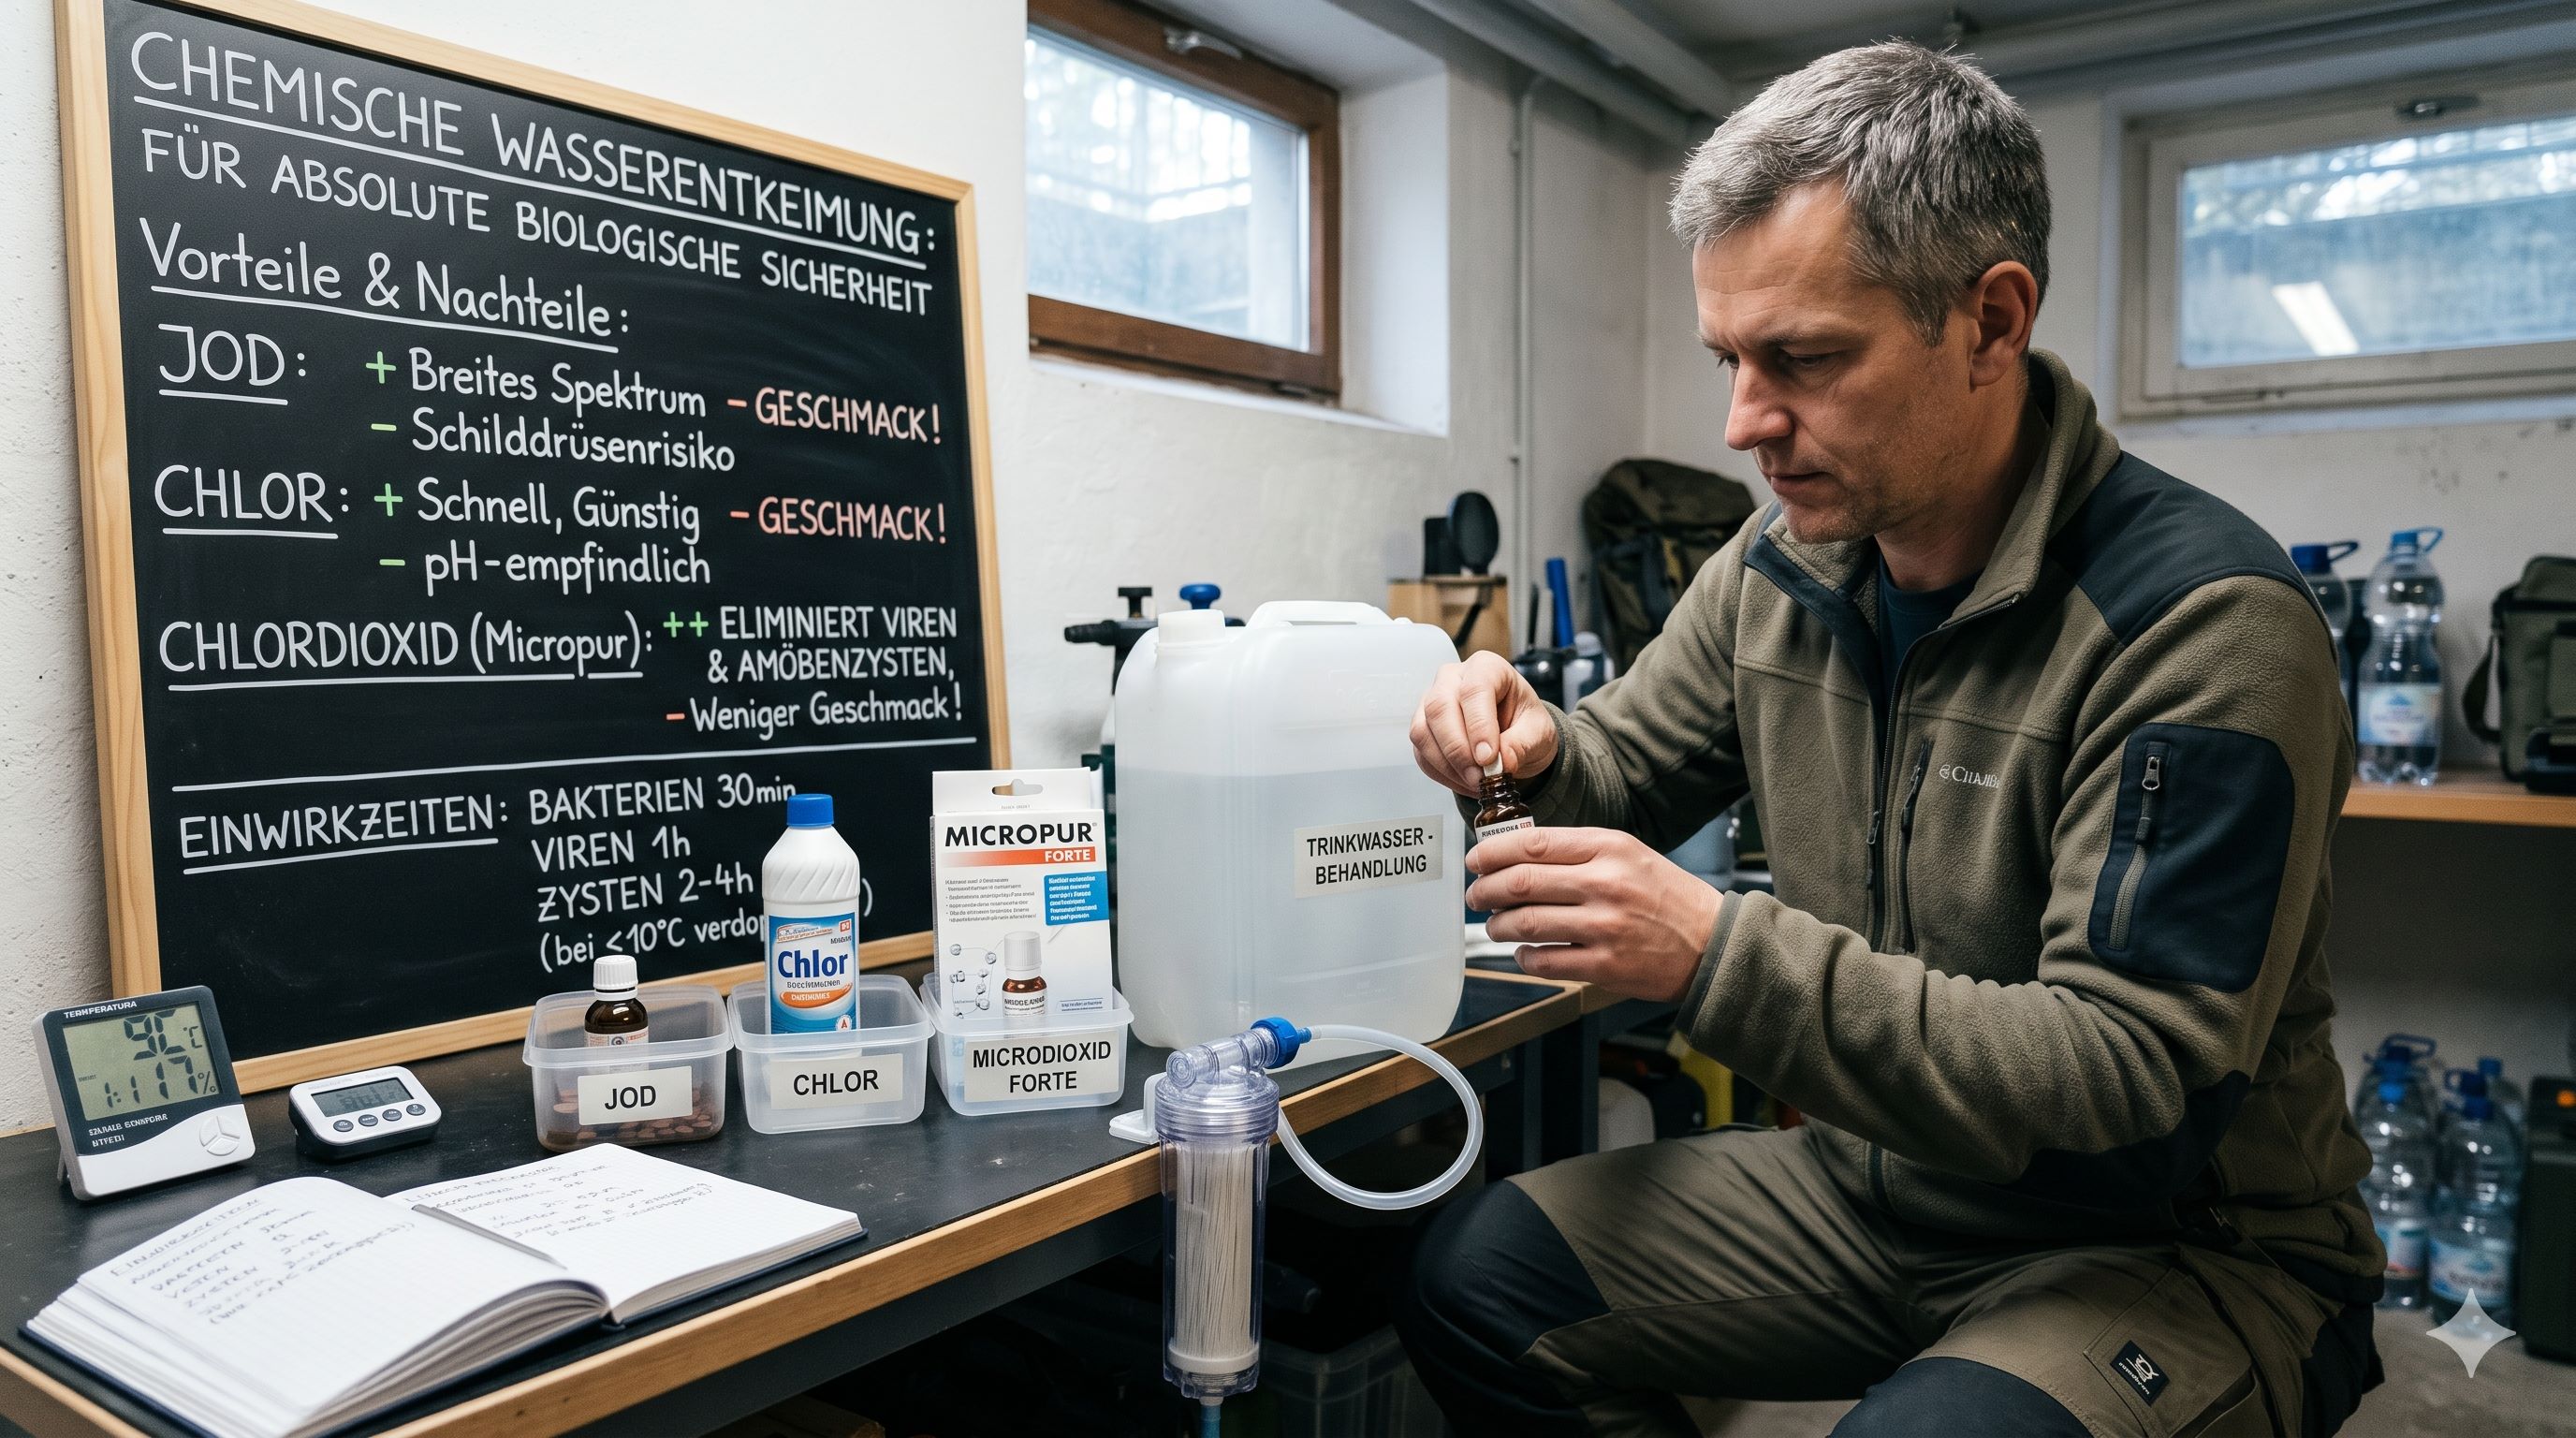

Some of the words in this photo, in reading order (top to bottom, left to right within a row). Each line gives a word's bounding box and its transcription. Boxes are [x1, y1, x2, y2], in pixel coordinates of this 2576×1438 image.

[131, 31, 464, 156] CHEMISCHE
[491, 113, 934, 255] WASSERENTKEIMUNG:
[141, 123, 246, 188] FÜR
[271, 154, 490, 232] ABSOLUTE
[516, 201, 740, 278] BIOLOGISCHE
[762, 251, 932, 315] SICHERHEIT
[139, 217, 342, 299] Vorteile
[365, 252, 400, 309] &
[417, 261, 628, 336] Nachteile:
[158, 324, 306, 386] JOD:
[409, 347, 537, 400] Breites
[551, 362, 706, 418] Spektrum
[755, 388, 940, 444] GESCHMACK!
[413, 407, 735, 471] Schilddrüsenrisiko
[154, 464, 348, 522] CHLOR:
[418, 477, 562, 535] Schnell,
[574, 486, 699, 545] Günstig
[759, 497, 945, 543] GESCHMACK!
[426, 539, 710, 596] pH-empfindlich
[160, 621, 458, 671] CHLORDIOXID
[471, 610, 651, 676] (Micropur):
[721, 606, 873, 639] ELIMINIERT
[882, 607, 956, 638] VIREN
[709, 649, 728, 682] &
[738, 643, 954, 682] AMÖBENZYSTEN,
[690, 697, 799, 741] Weniger
[810, 682, 961, 725] Geschmack!
[181, 794, 507, 858] EINWIRKZEITEN:
[530, 777, 703, 825] BAKTERIEN
[945, 823, 1093, 847] MICROPUR
[532, 829, 634, 872] VIREN
[652, 826, 690, 858] 1h
[1045, 849, 1090, 862] FORTE
[1307, 828, 1424, 857] TRINKWASSER
[538, 873, 664, 922] ZYSTEN
[679, 862, 753, 902] 2-4h
[1316, 854, 1427, 885] BEHANDLUNG
[541, 932, 593, 973] (bei
[778, 949, 848, 978] Chlor
[973, 1041, 1111, 1068] MICRODIOXID
[605, 1085, 656, 1110] JOD
[794, 1069, 879, 1096] CHLOR
[1010, 1071, 1077, 1093] FORTE
